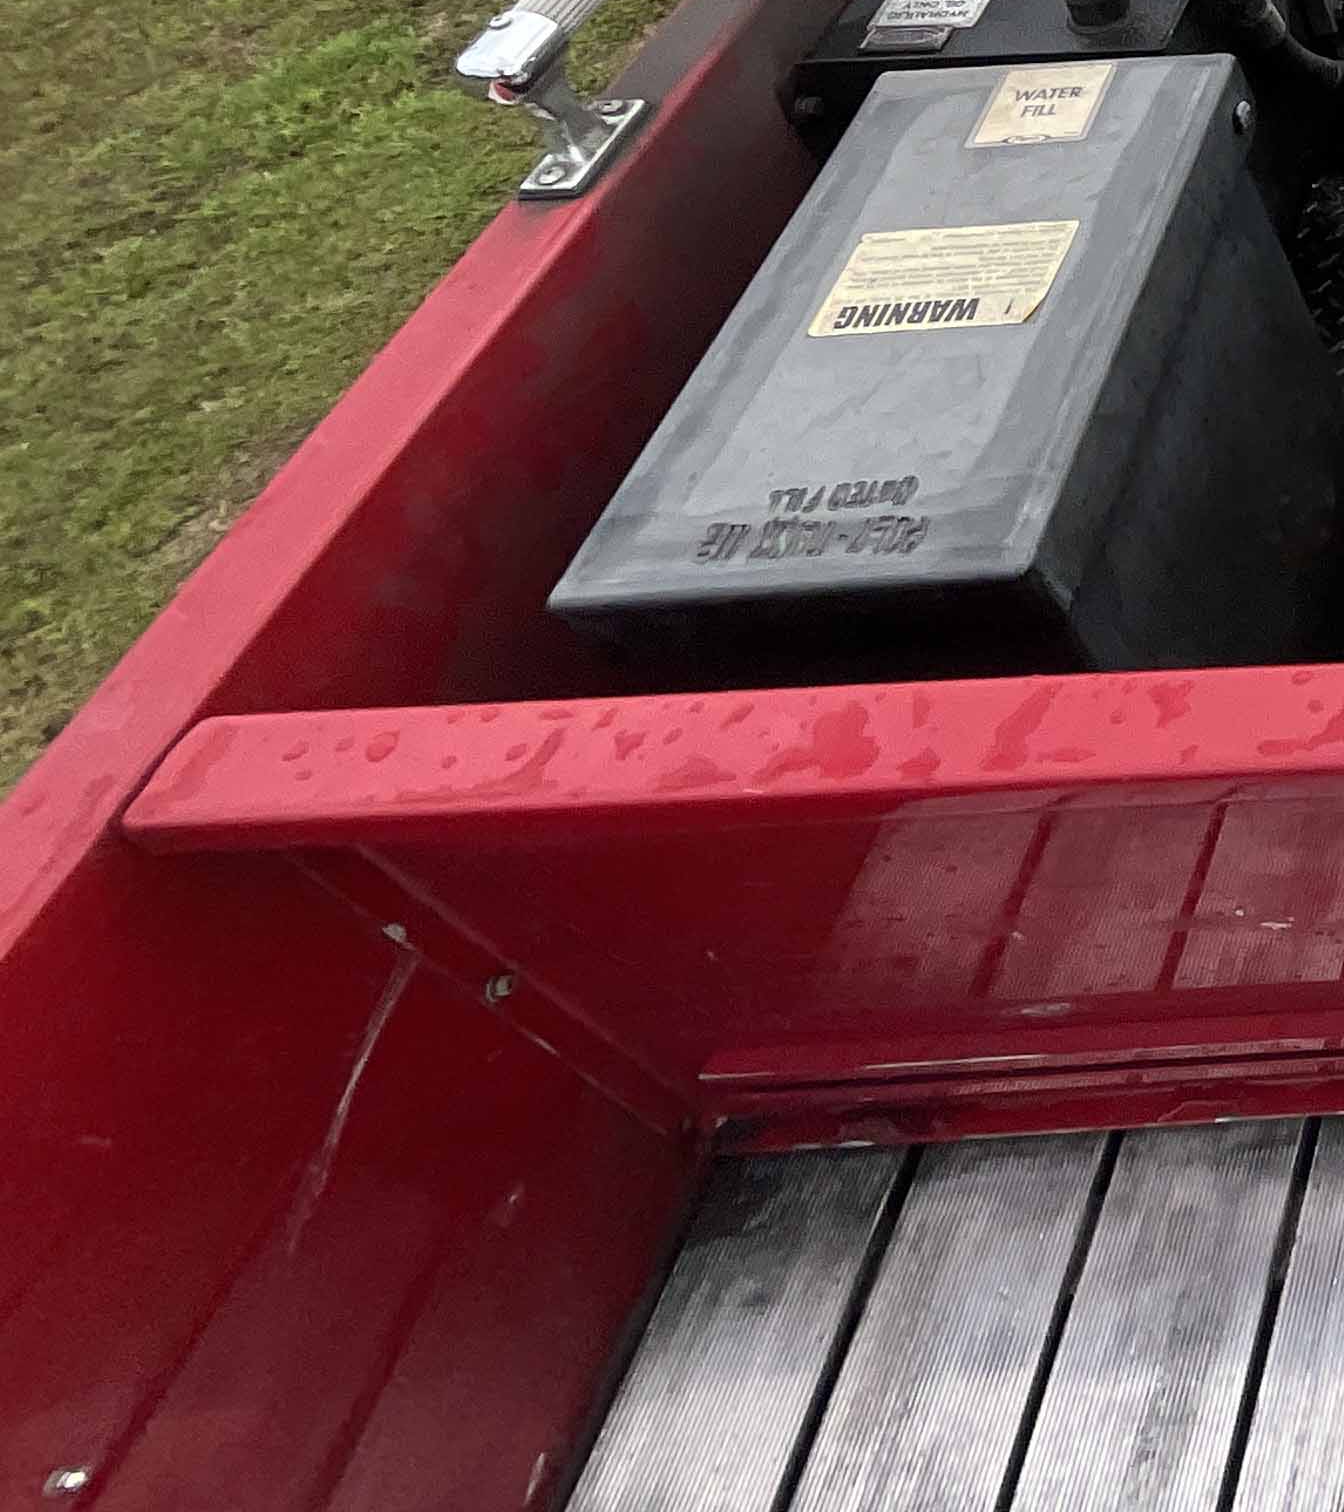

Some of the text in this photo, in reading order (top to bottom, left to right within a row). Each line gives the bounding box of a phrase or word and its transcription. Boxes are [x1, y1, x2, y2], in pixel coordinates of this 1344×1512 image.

[1015, 86, 1083, 102] WATER
[1020, 104, 1057, 118] FILL
[833, 297, 980, 330] WARNING
